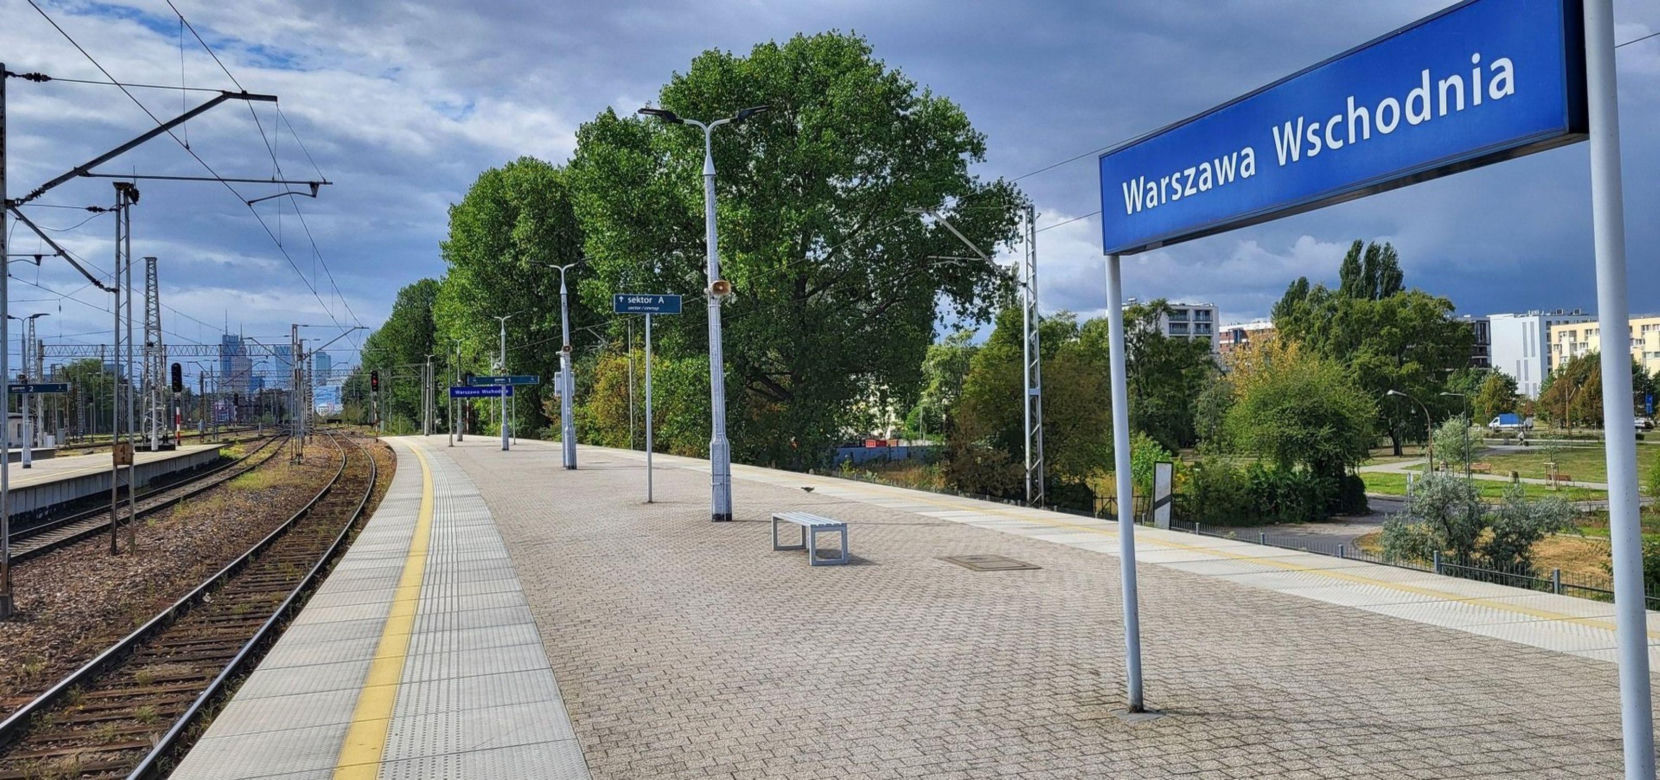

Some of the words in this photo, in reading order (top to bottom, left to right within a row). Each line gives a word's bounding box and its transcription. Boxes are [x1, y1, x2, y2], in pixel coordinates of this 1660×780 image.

[1122, 145, 1256, 215] Warszawa
[1272, 53, 1515, 167] Wschodnia
[627, 296, 653, 304] sektor
[658, 296, 665, 304] A
